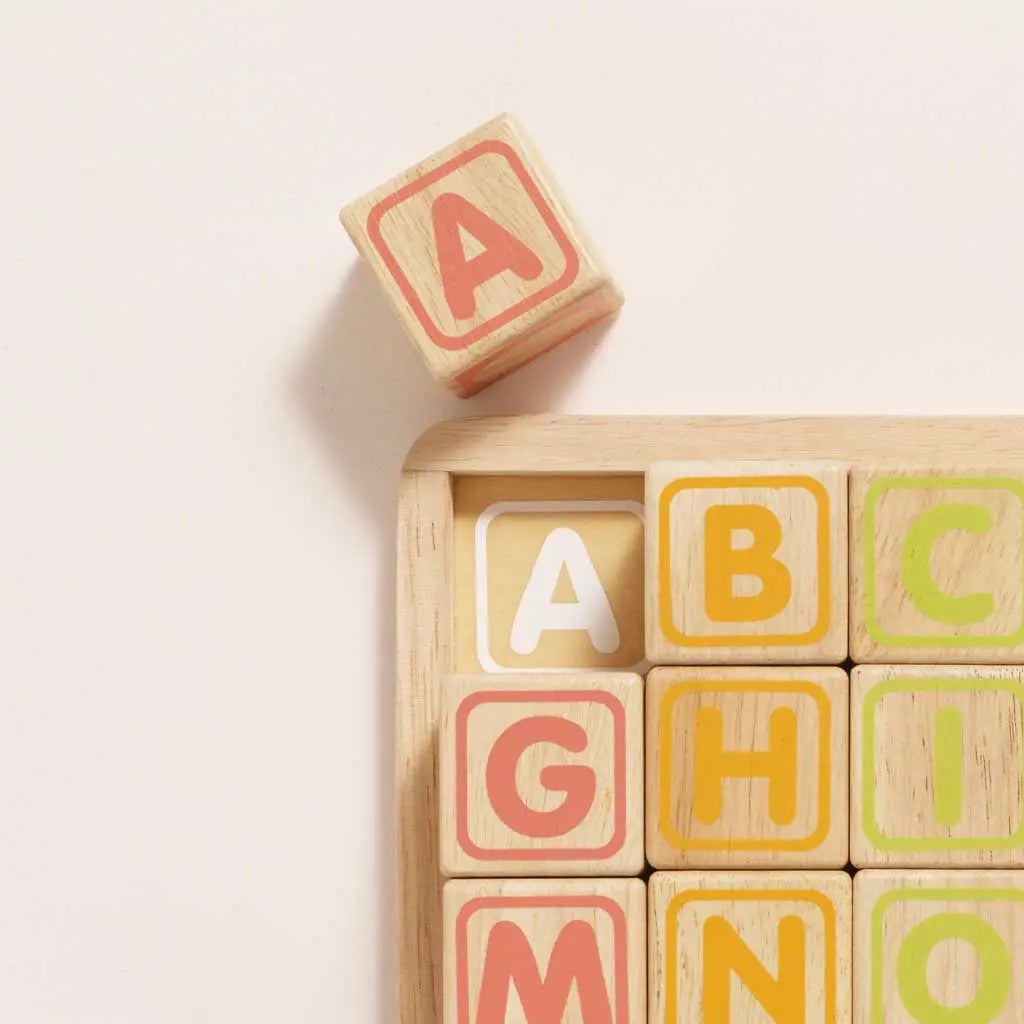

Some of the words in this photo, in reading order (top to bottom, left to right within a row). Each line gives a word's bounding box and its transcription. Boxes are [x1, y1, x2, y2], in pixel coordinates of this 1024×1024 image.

[431, 192, 543, 320] A
[509, 527, 620, 654] A
[704, 503, 792, 622] B
[900, 503, 994, 625] C
[486, 716, 597, 838] G
[694, 706, 797, 826] H
[934, 707, 962, 828] I
